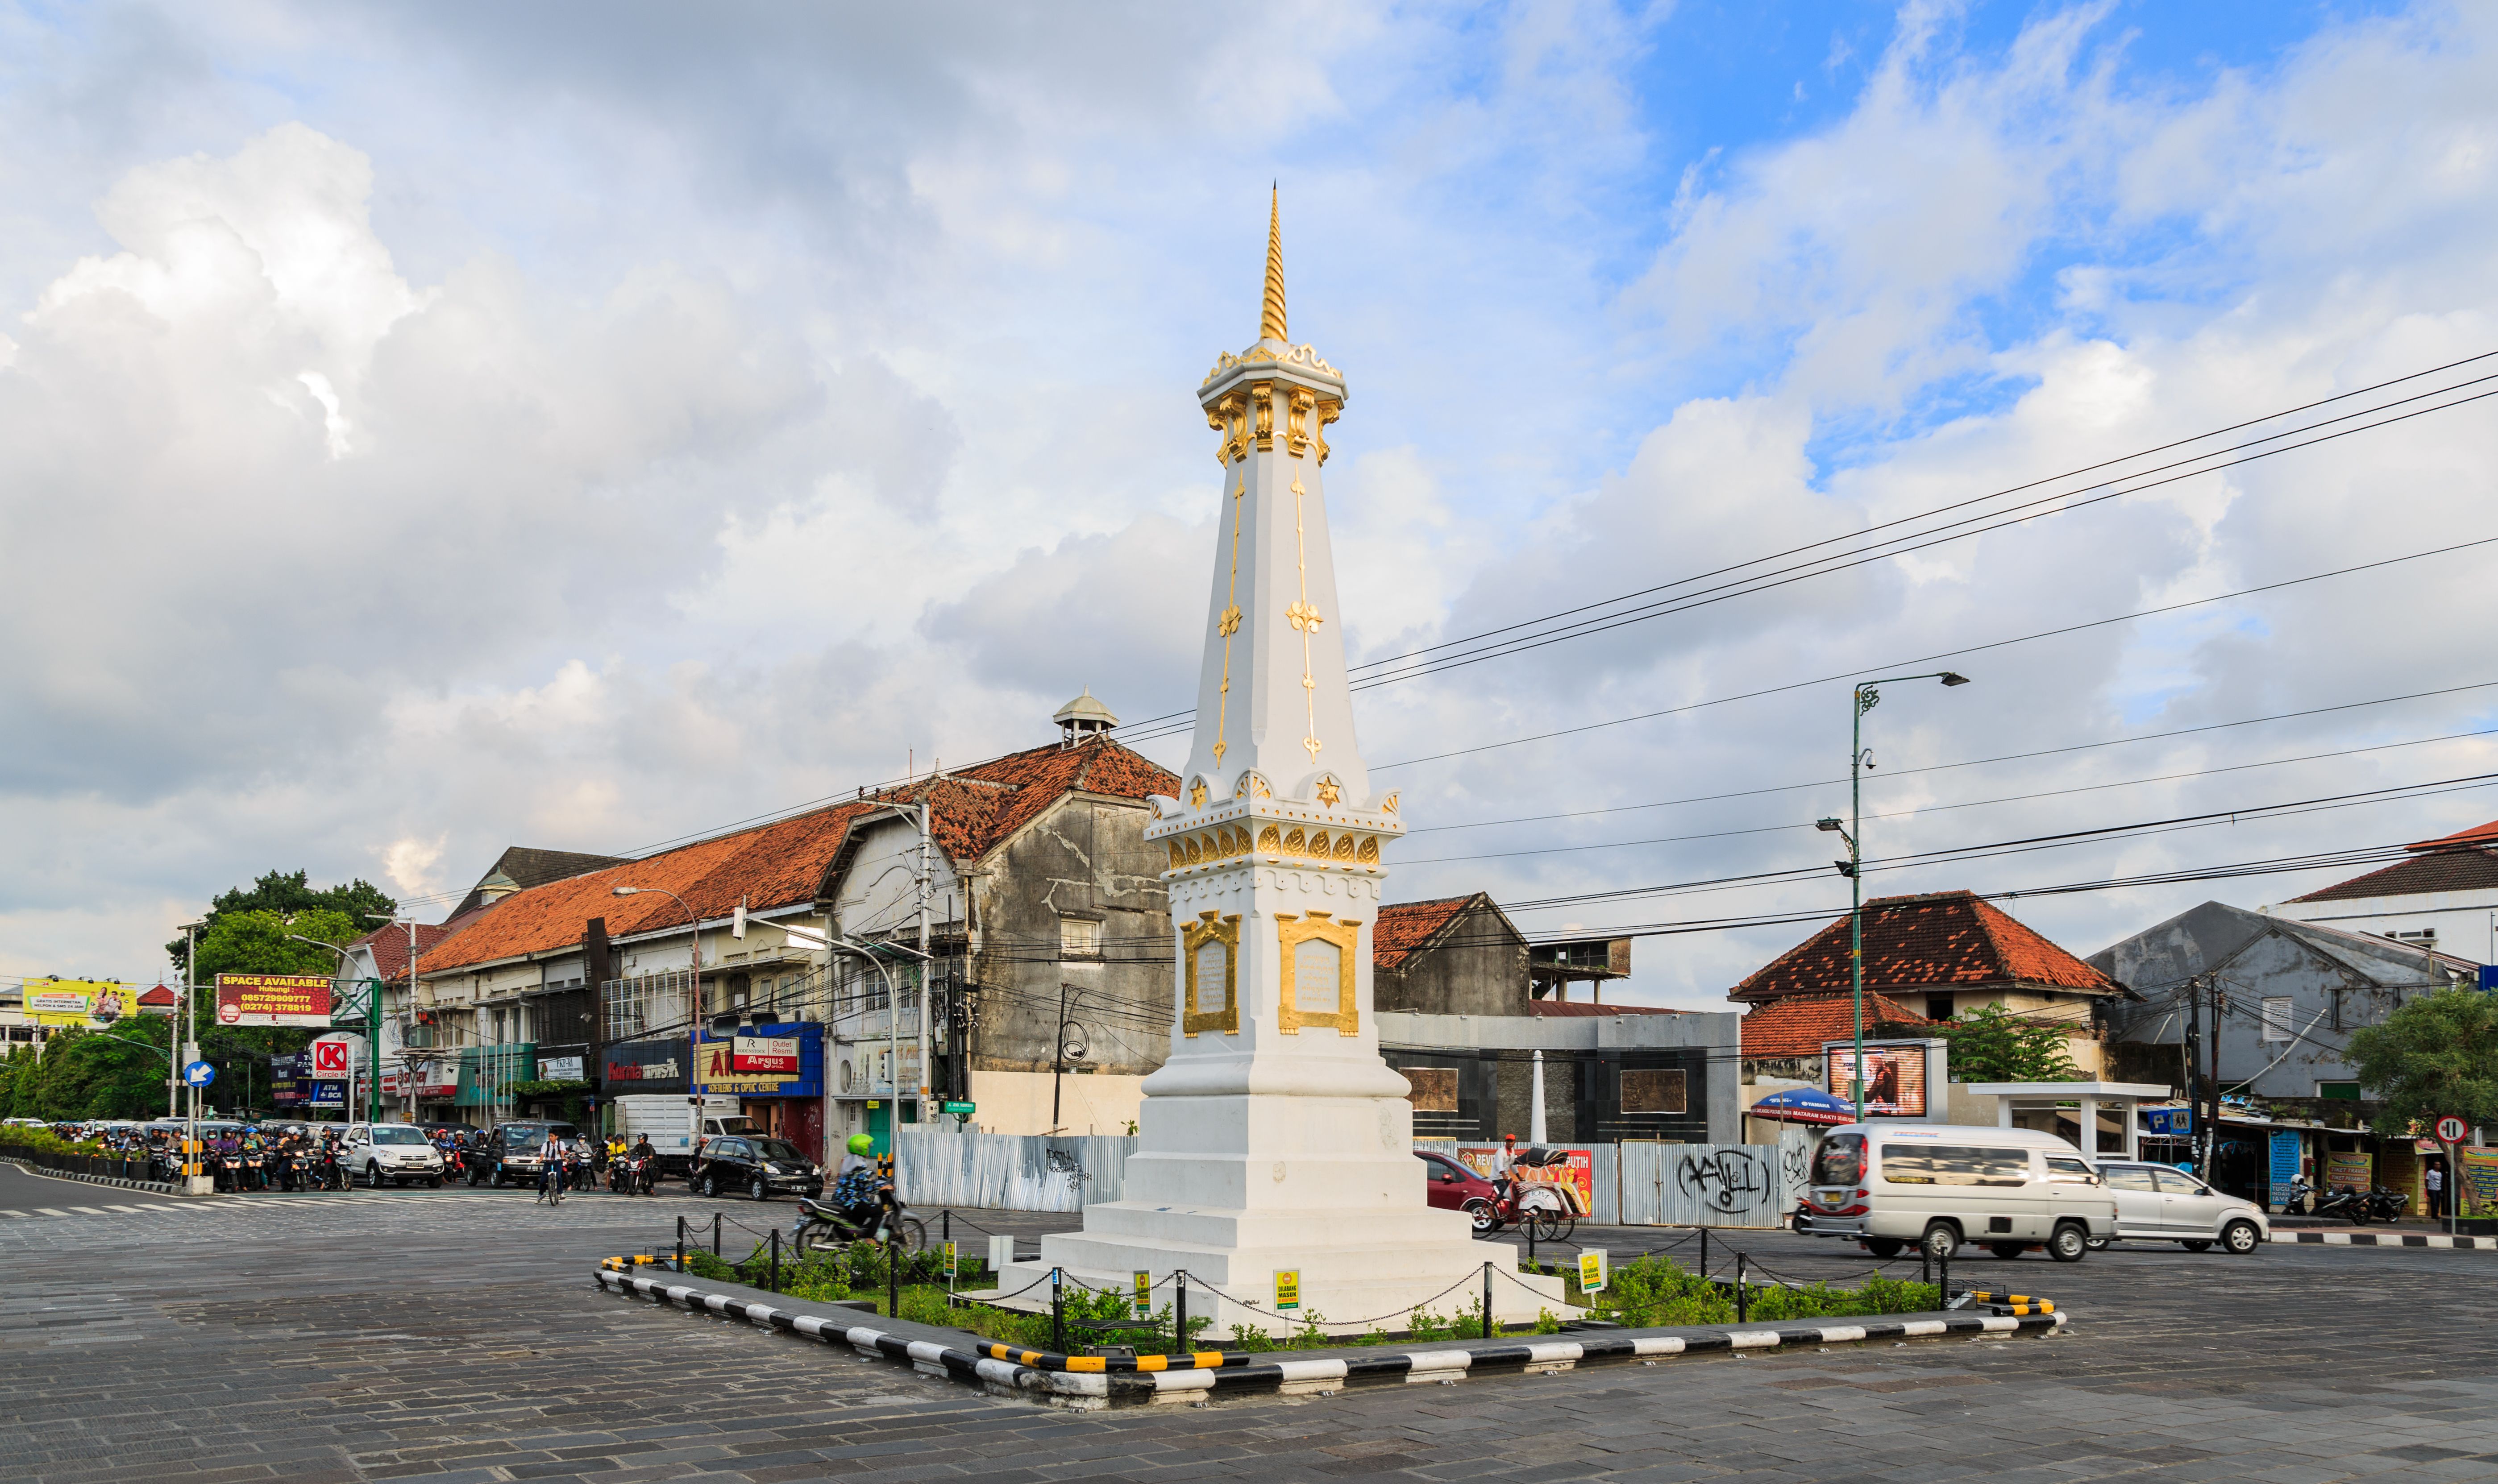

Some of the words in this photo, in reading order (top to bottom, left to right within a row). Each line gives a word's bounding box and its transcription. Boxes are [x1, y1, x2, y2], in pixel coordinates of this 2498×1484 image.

[223, 976, 261, 985] SPACE
[264, 978, 328, 987] AVAILABLE
[241, 994, 311, 1002] 085729909777
[240, 1003, 272, 1011] (0274)
[557, 1058, 573, 1068] PKP-RI
[747, 1056, 784, 1068] Argus
[608, 1061, 643, 1081] Kurnia
[403, 1071, 426, 1084] SIGER
[708, 1083, 732, 1093] SOFTLENS
[735, 1083, 739, 1093] &
[741, 1083, 757, 1092] OPTIC
[759, 1082, 779, 1092] CENTRE
[1793, 1111, 1819, 1119] MATARAM
[1566, 1156, 1588, 1169] PUTIH
